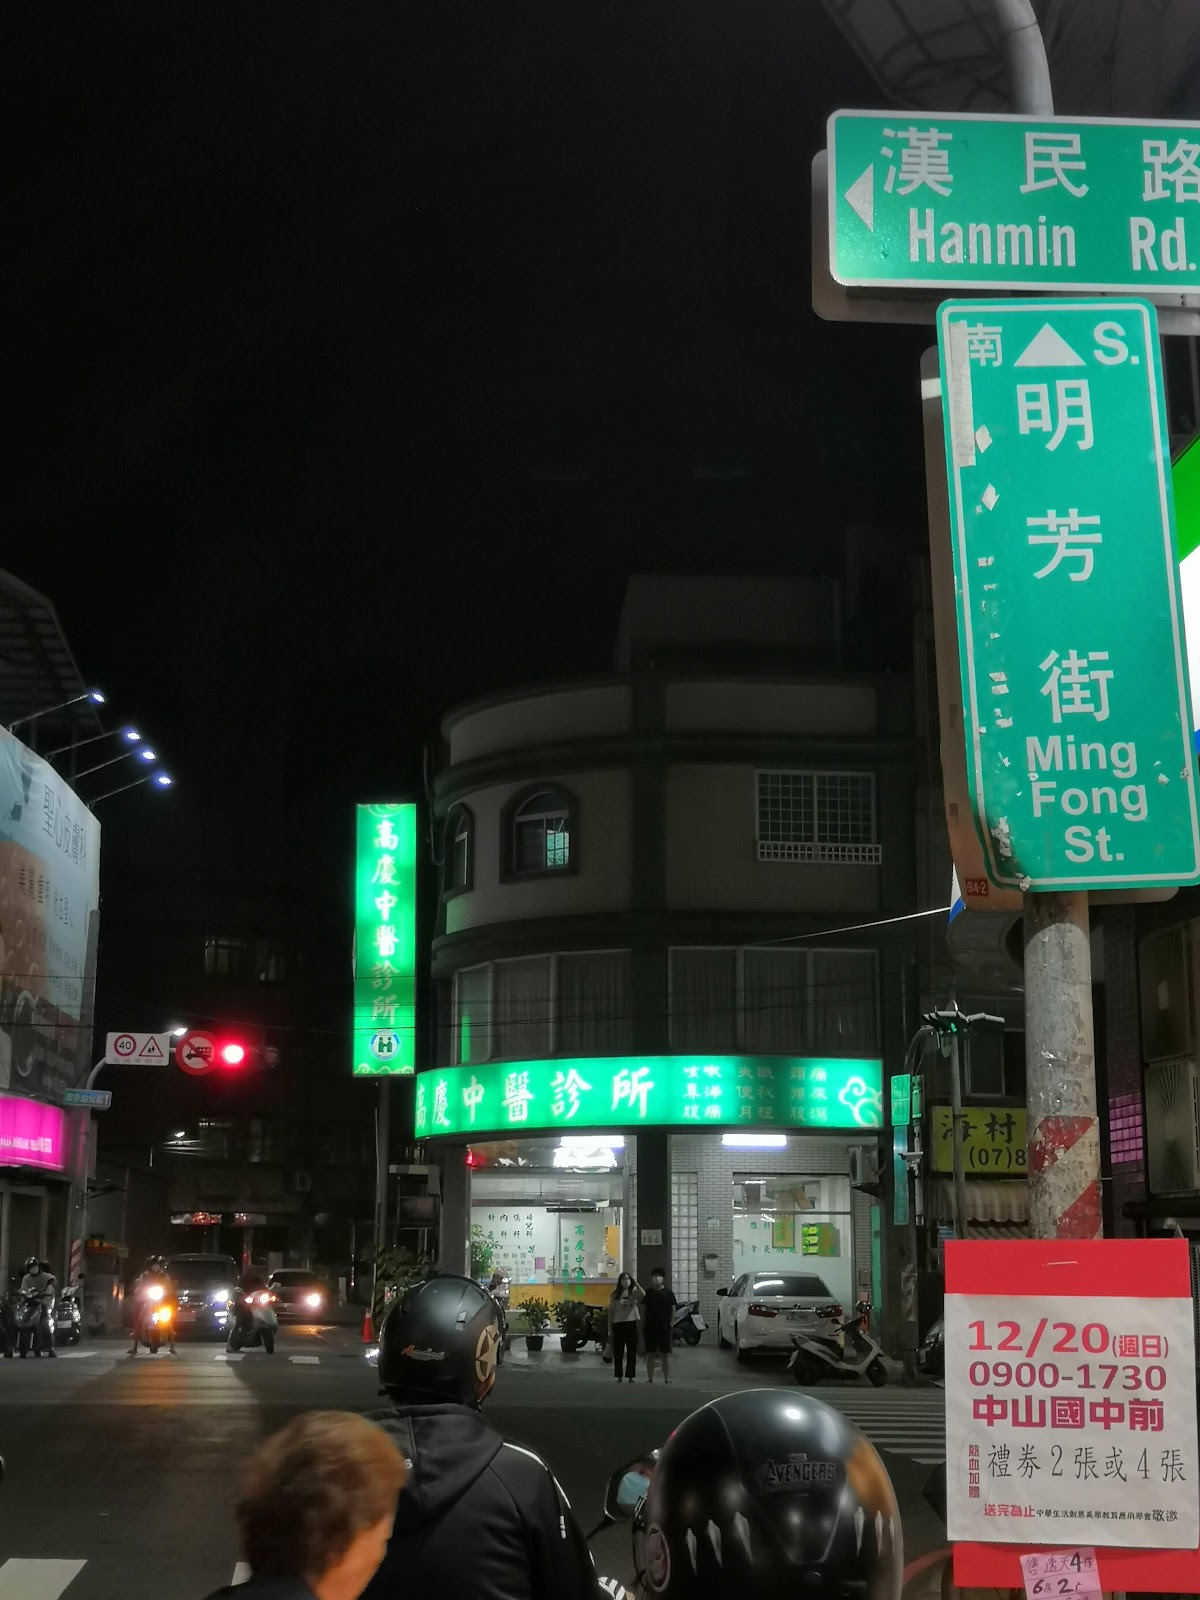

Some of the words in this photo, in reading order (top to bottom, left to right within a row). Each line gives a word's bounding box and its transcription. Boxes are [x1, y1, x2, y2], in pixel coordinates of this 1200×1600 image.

[880, 127, 1200, 203] 漢民路
[908, 207, 1077, 267] Hanmin
[1130, 217, 1197, 271] Rd.
[965, 322, 1004, 367] 南
[1093, 321, 1140, 365] S.
[1016, 379, 1114, 723] 明芳街
[1025, 734, 1138, 778] Ming
[1032, 781, 1148, 822] Fong
[1064, 826, 1125, 862] St.
[371, 819, 401, 1026] 高慶中醫診所
[118, 1041, 132, 1050] 40
[416, 1066, 653, 1129] 高慶中醫診所
[967, 1318, 1169, 1358] 12/20(週日)
[968, 1361, 1167, 1391] 0900-1730
[972, 1394, 1165, 1431] 中山國中前
